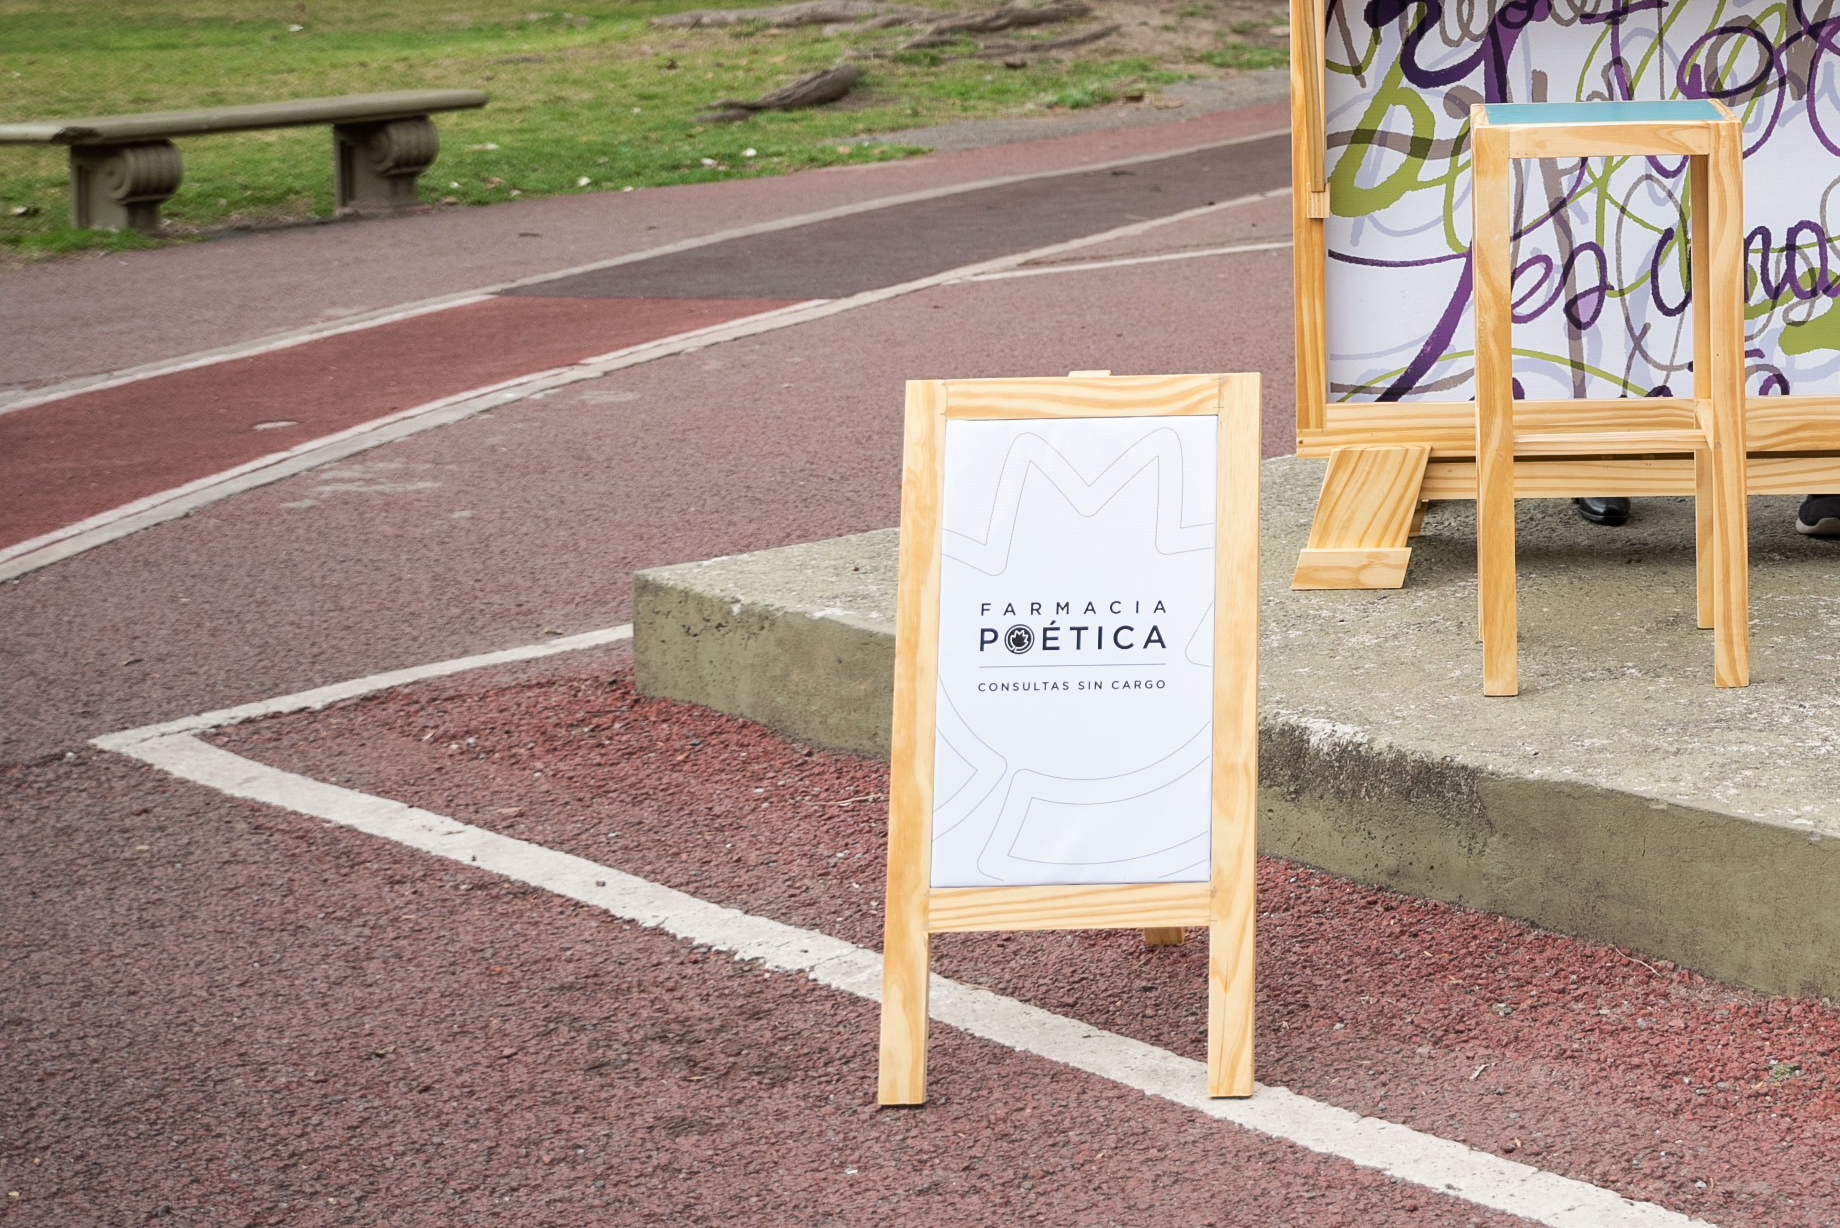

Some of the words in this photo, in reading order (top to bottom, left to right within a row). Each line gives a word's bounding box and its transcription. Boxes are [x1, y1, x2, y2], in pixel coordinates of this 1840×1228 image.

[981, 600, 1166, 616] FARMACIA
[979, 620, 1167, 654] POÉTICA
[978, 681, 1070, 692] CONSULTAS
[1078, 681, 1103, 690] SIN
[1111, 679, 1166, 690] CARGO
